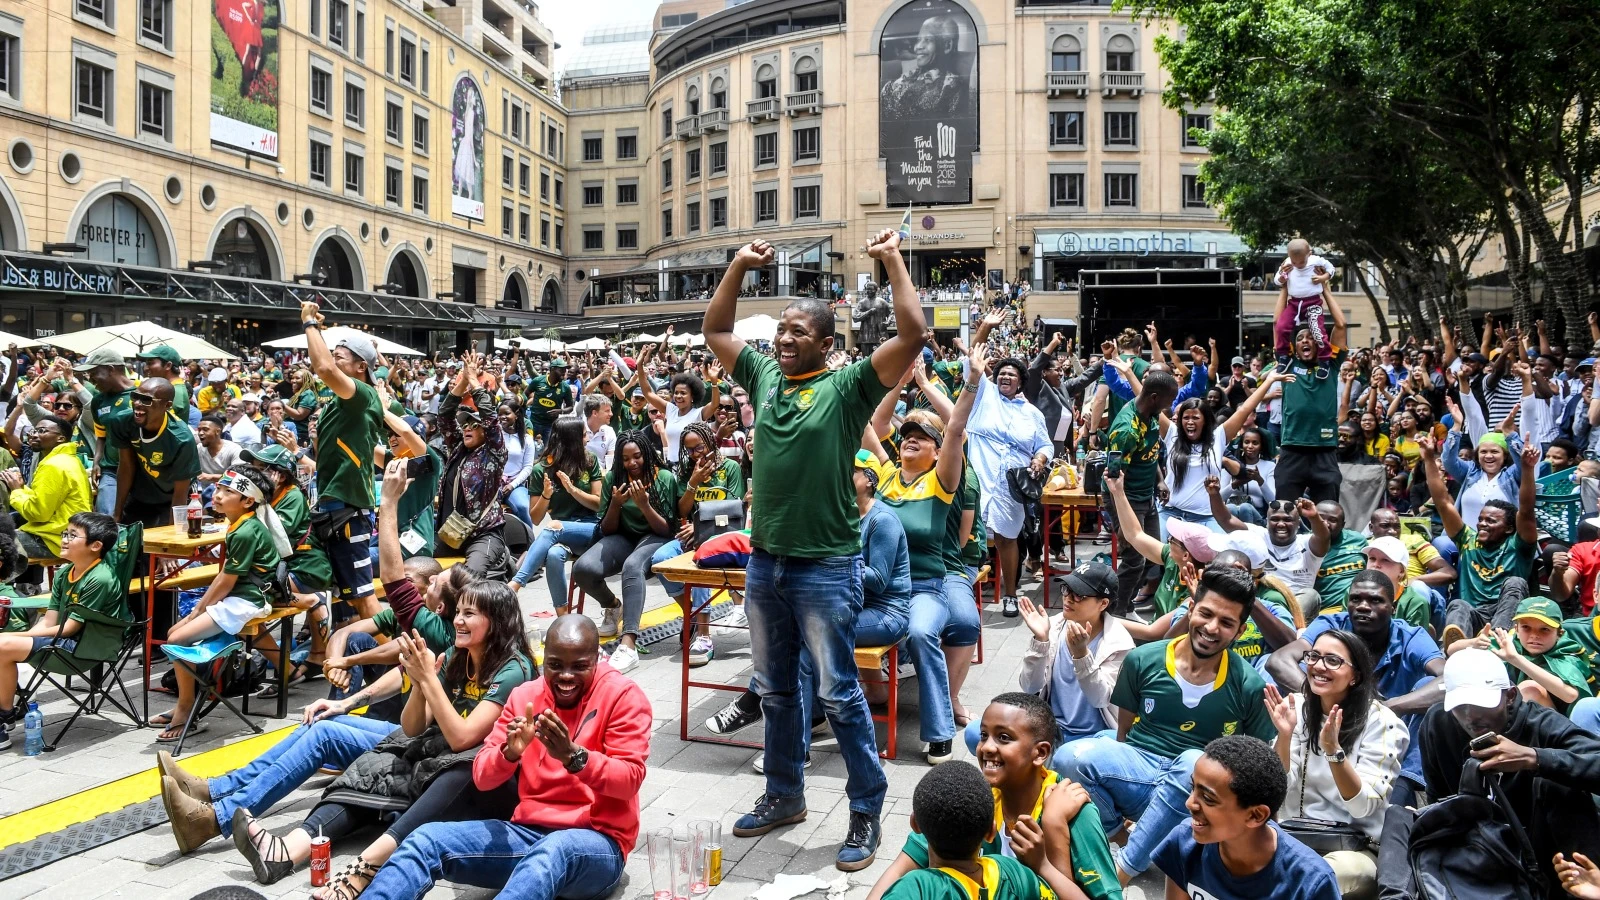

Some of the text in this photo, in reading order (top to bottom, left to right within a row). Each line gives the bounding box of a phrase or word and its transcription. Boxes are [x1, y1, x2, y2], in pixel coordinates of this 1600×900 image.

[914, 135, 933, 149] Find
[936, 122, 956, 158] 100
[917, 148, 933, 161] the
[900, 161, 933, 175] Madiba
[936, 169, 956, 179] 2018
[907, 175, 933, 192] in you
[81, 224, 146, 249] FOREVER 21
[926, 232, 966, 240] MANDELA
[1087, 231, 1193, 257] wangthai
[44, 269, 114, 293] BUTCHERY
[36, 329, 56, 337] TRUMPS
[696, 490, 719, 500] MTN
[1318, 560, 1364, 577] CASTLE
